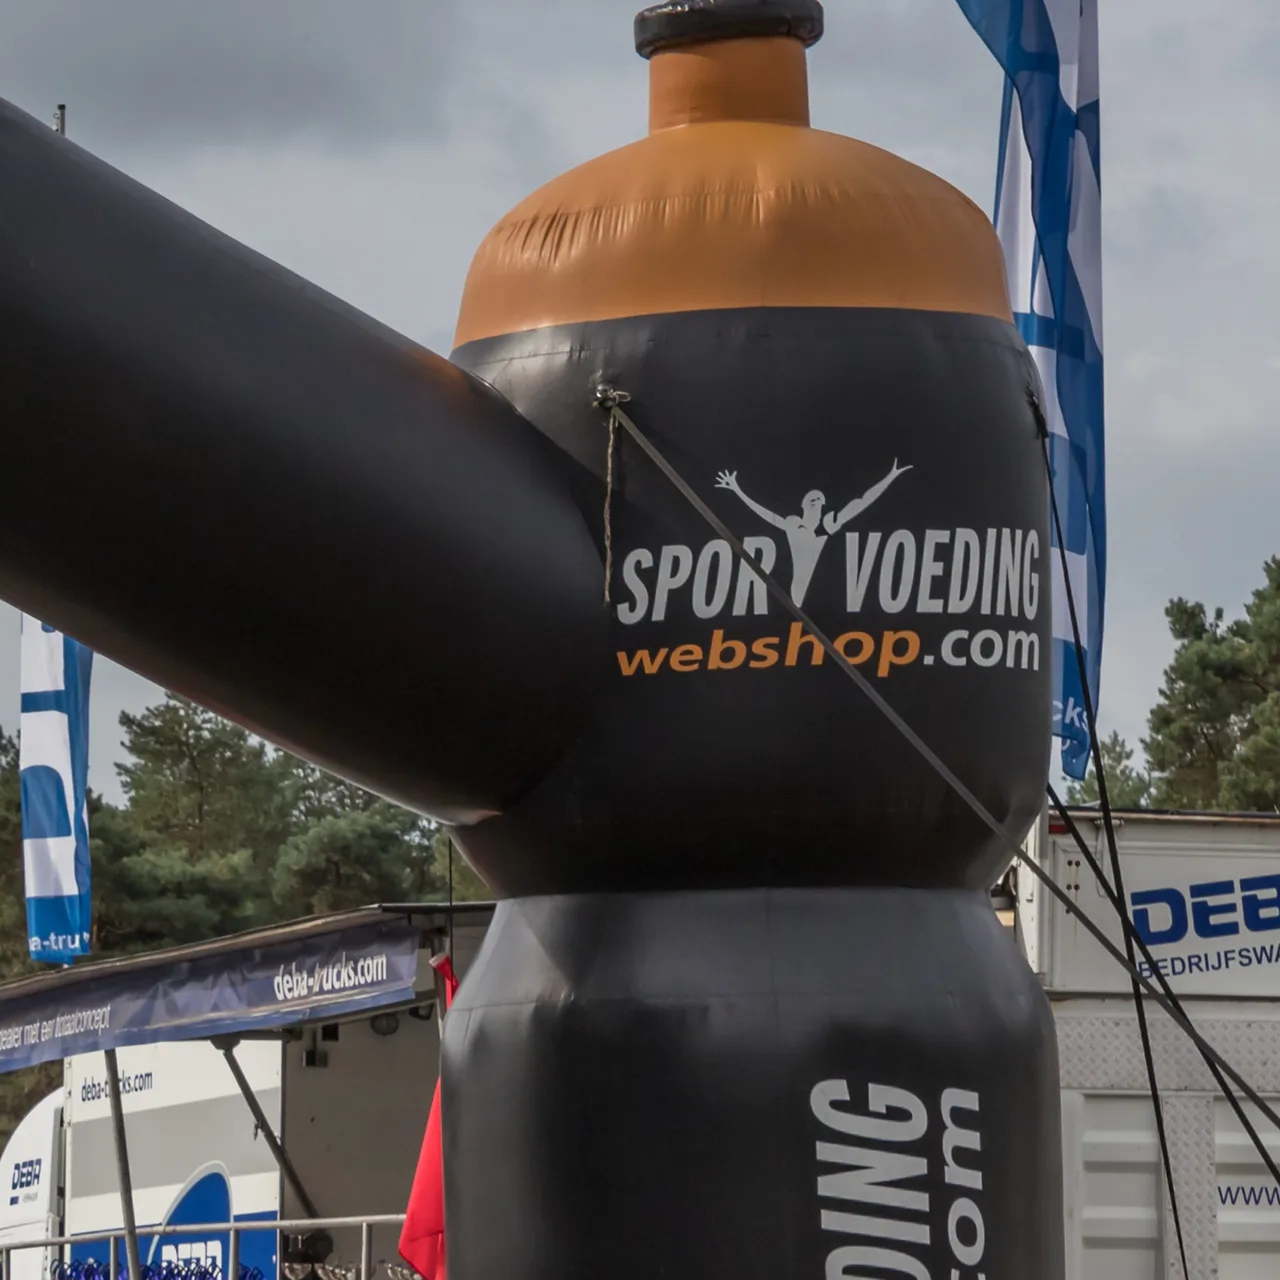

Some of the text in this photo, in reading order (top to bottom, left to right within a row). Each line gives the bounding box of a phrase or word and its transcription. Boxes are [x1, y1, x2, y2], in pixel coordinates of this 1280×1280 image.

[617, 623, 1039, 677] webshop.com
[274, 952, 387, 1000] deba-trucks.com
[81, 1070, 153, 1102] deba-tcks.com
[11, 1158, 42, 1190] DEBA
